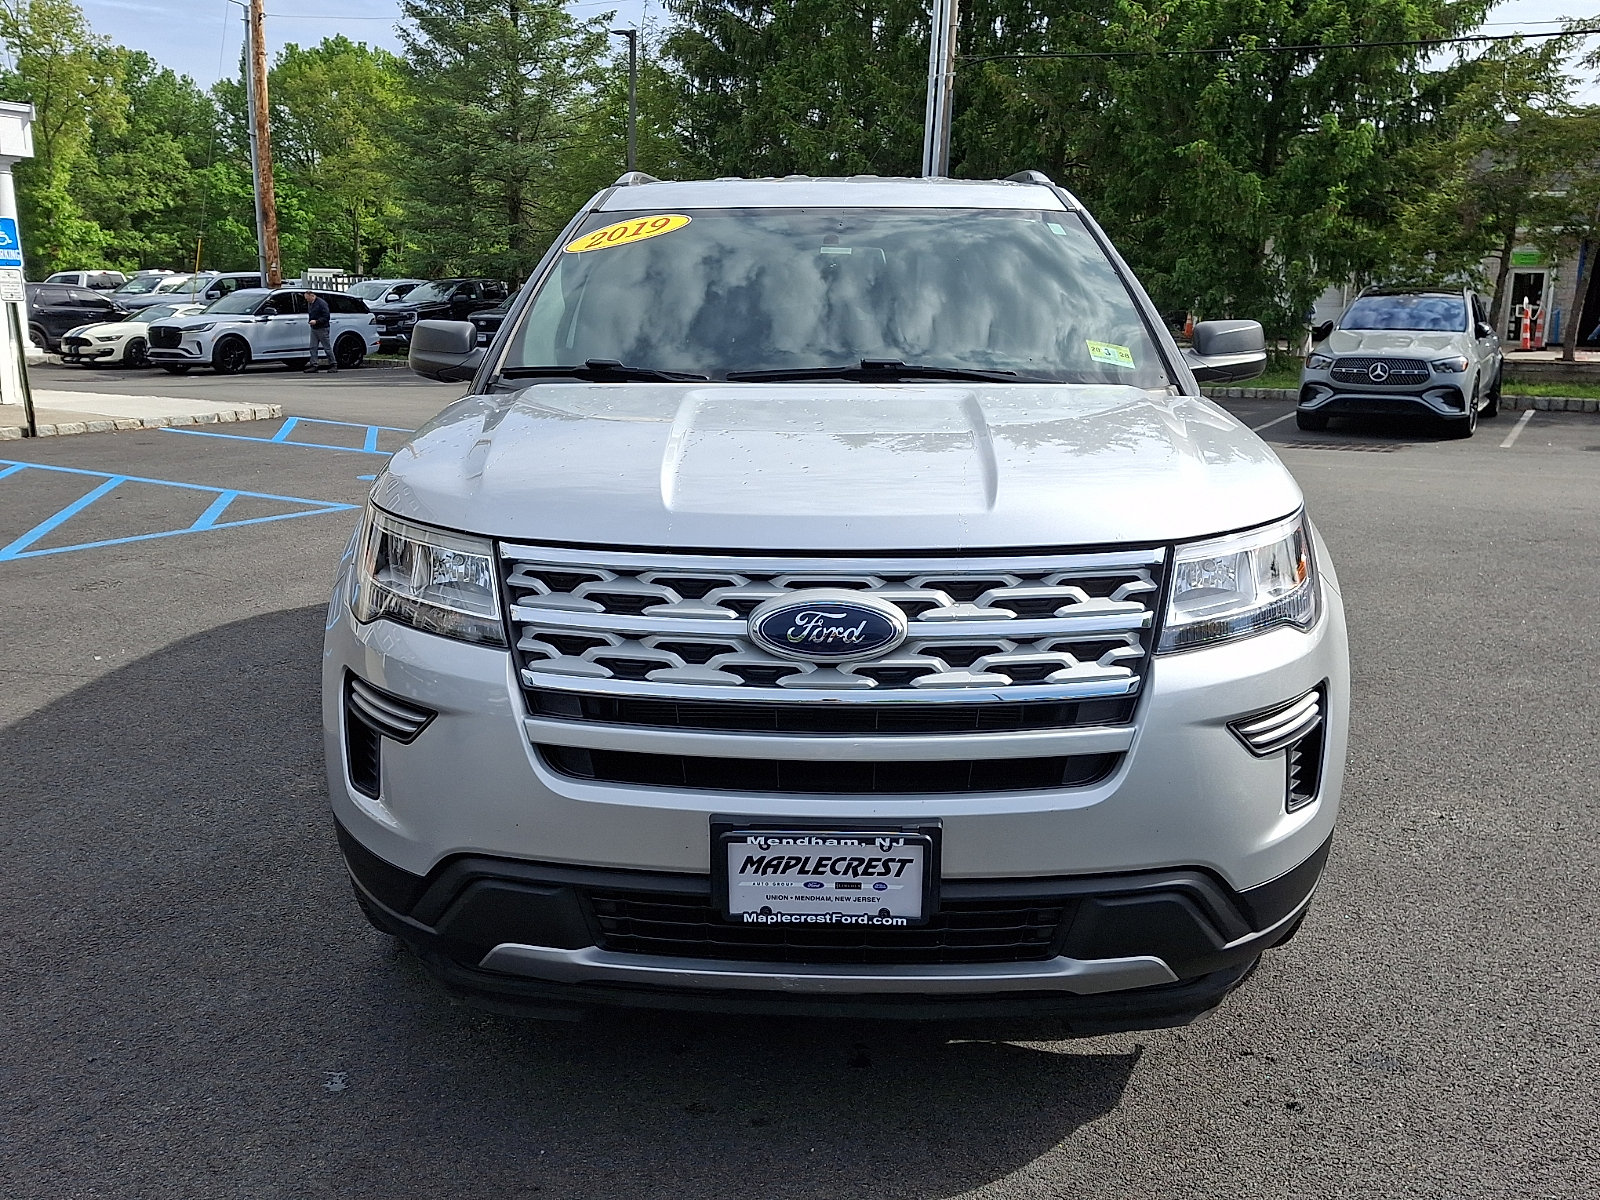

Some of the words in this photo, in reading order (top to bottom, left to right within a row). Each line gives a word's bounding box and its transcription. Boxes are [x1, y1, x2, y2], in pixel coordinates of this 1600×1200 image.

[585, 217, 671, 249] 2019
[786, 611, 867, 643] Ford
[747, 836, 866, 848] Mendham,
[875, 837, 904, 848] NJ
[738, 855, 914, 879] MAPLECREST
[743, 913, 907, 926] MaplecrestFord.com
